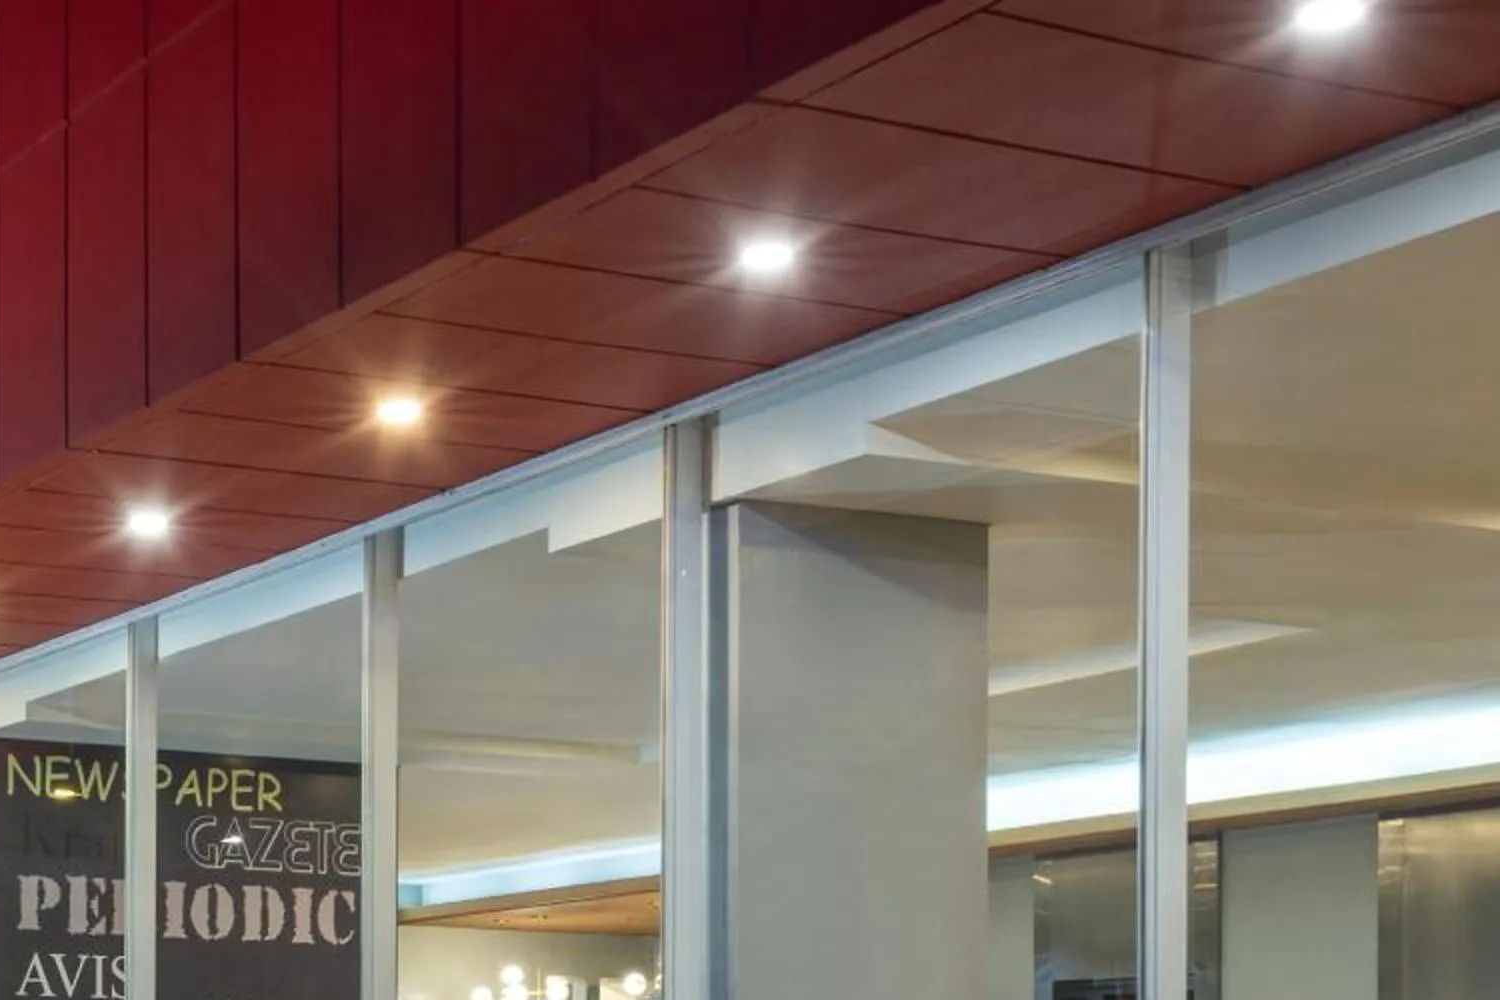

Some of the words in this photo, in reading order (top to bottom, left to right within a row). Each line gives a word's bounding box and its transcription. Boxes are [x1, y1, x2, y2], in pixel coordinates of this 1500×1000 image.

[7, 752, 283, 812] NEWPAPER
[185, 815, 361, 876] GAZETE
[14, 951, 127, 1000] AVIS
